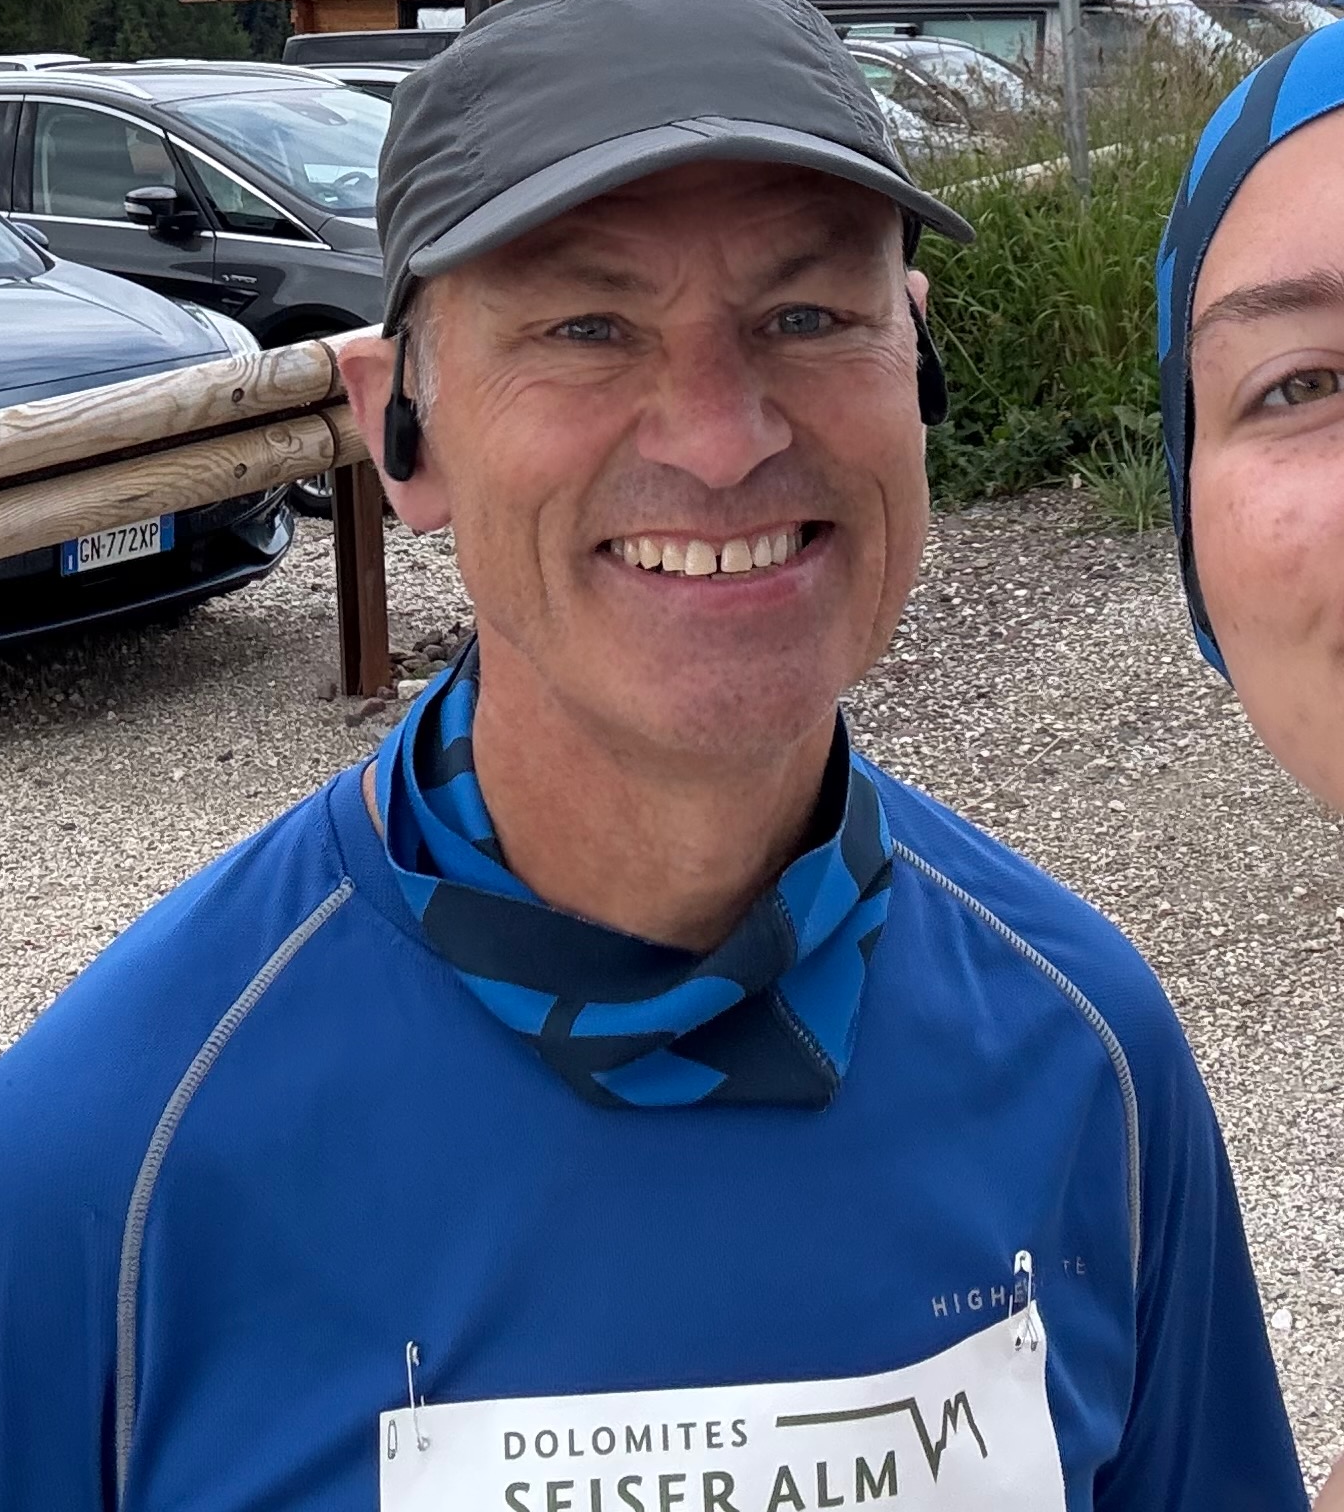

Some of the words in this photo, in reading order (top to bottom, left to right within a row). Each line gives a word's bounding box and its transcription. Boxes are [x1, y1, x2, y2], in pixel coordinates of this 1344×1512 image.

[504, 1419, 748, 1460] DOLOMITES
[505, 1470, 742, 1512] SEISER
[766, 1450, 899, 1512] ALM
